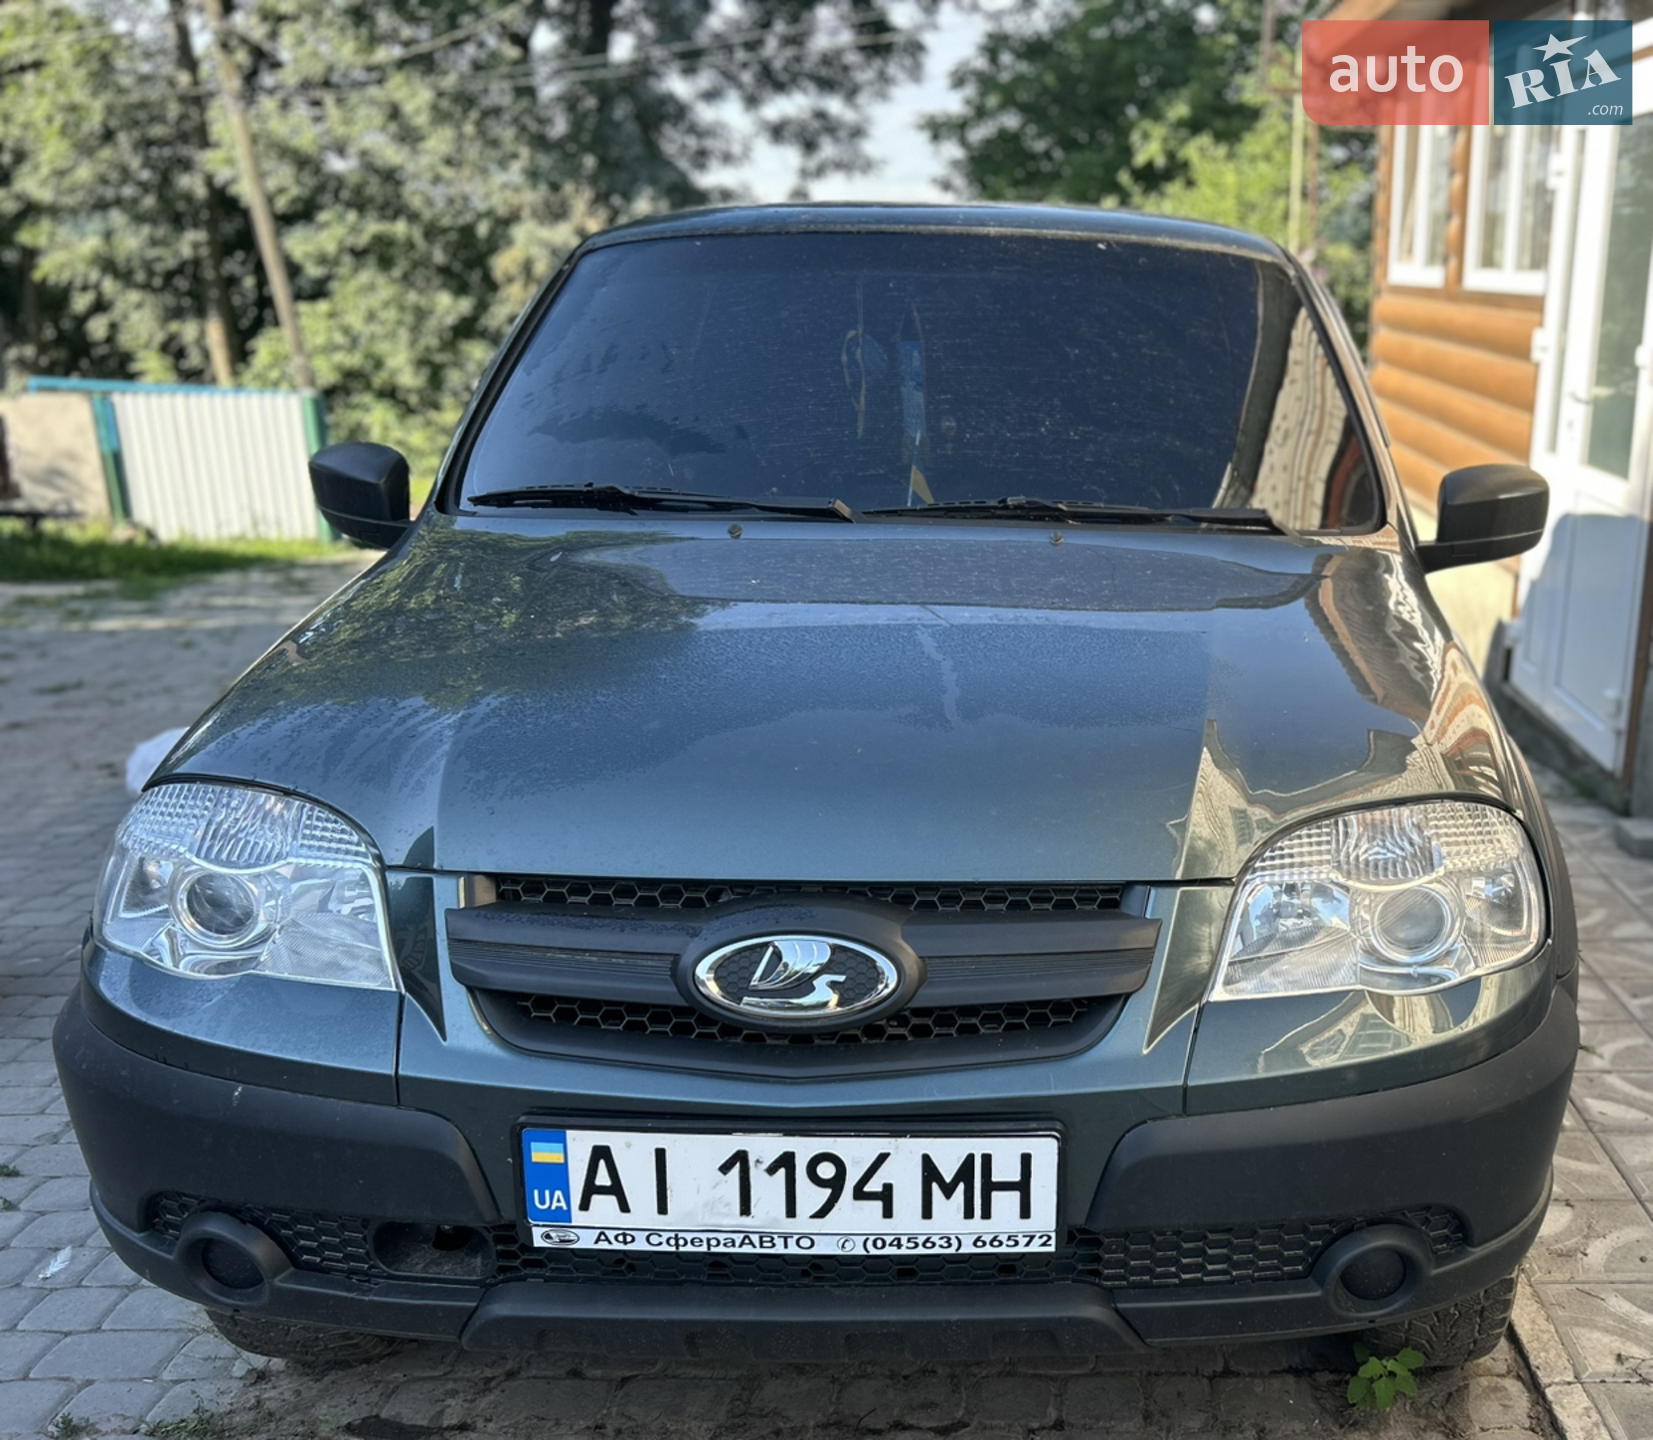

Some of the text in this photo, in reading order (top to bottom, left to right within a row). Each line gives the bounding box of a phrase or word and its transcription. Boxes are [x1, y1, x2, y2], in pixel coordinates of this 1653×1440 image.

[717, 1149, 894, 1220] 1194
[920, 1151, 1032, 1221] MH
[533, 1188, 568, 1211] UA
[593, 1231, 1053, 1254] АФ СфераАВТО (04563) 66572
